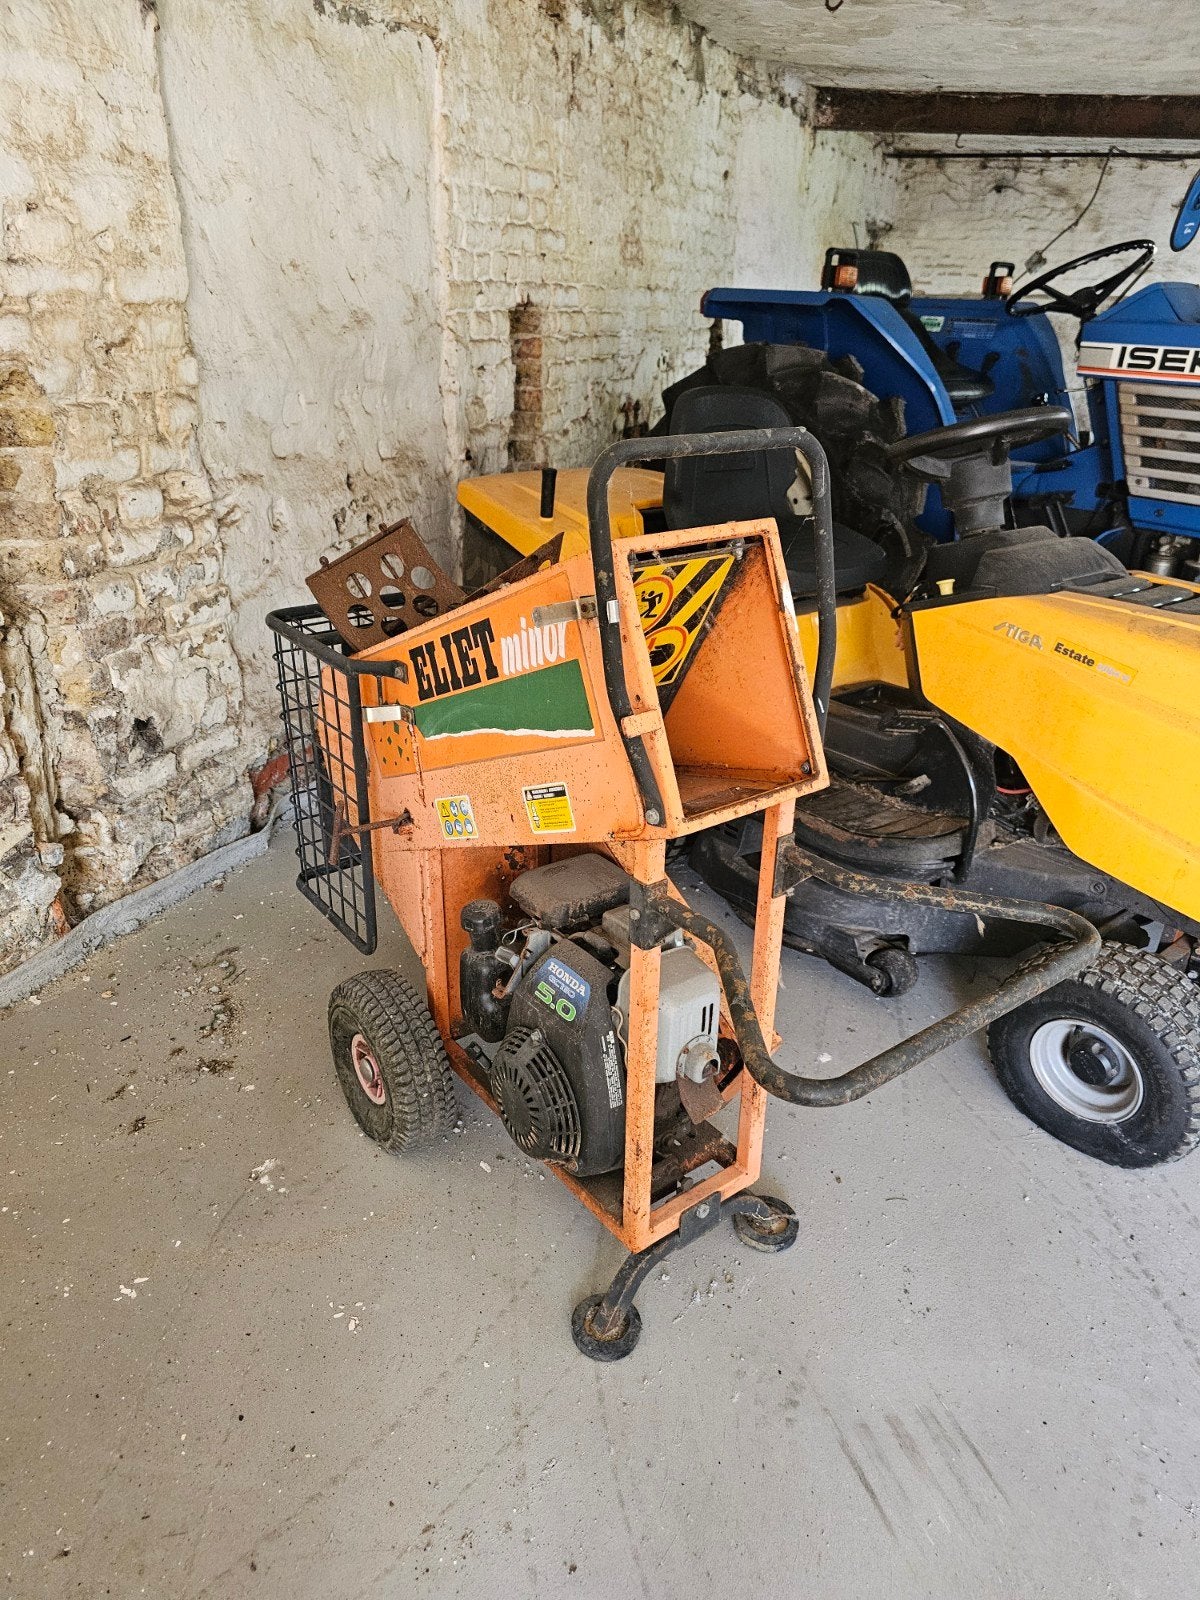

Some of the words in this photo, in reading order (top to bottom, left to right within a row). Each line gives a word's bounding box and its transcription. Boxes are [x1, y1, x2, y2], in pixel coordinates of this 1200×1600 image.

[409, 618, 500, 701] ELIET
[501, 617, 567, 676] minor
[1054, 642, 1095, 667] Estate
[548, 961, 586, 997] HONDA
[534, 981, 577, 1022] 5.0
